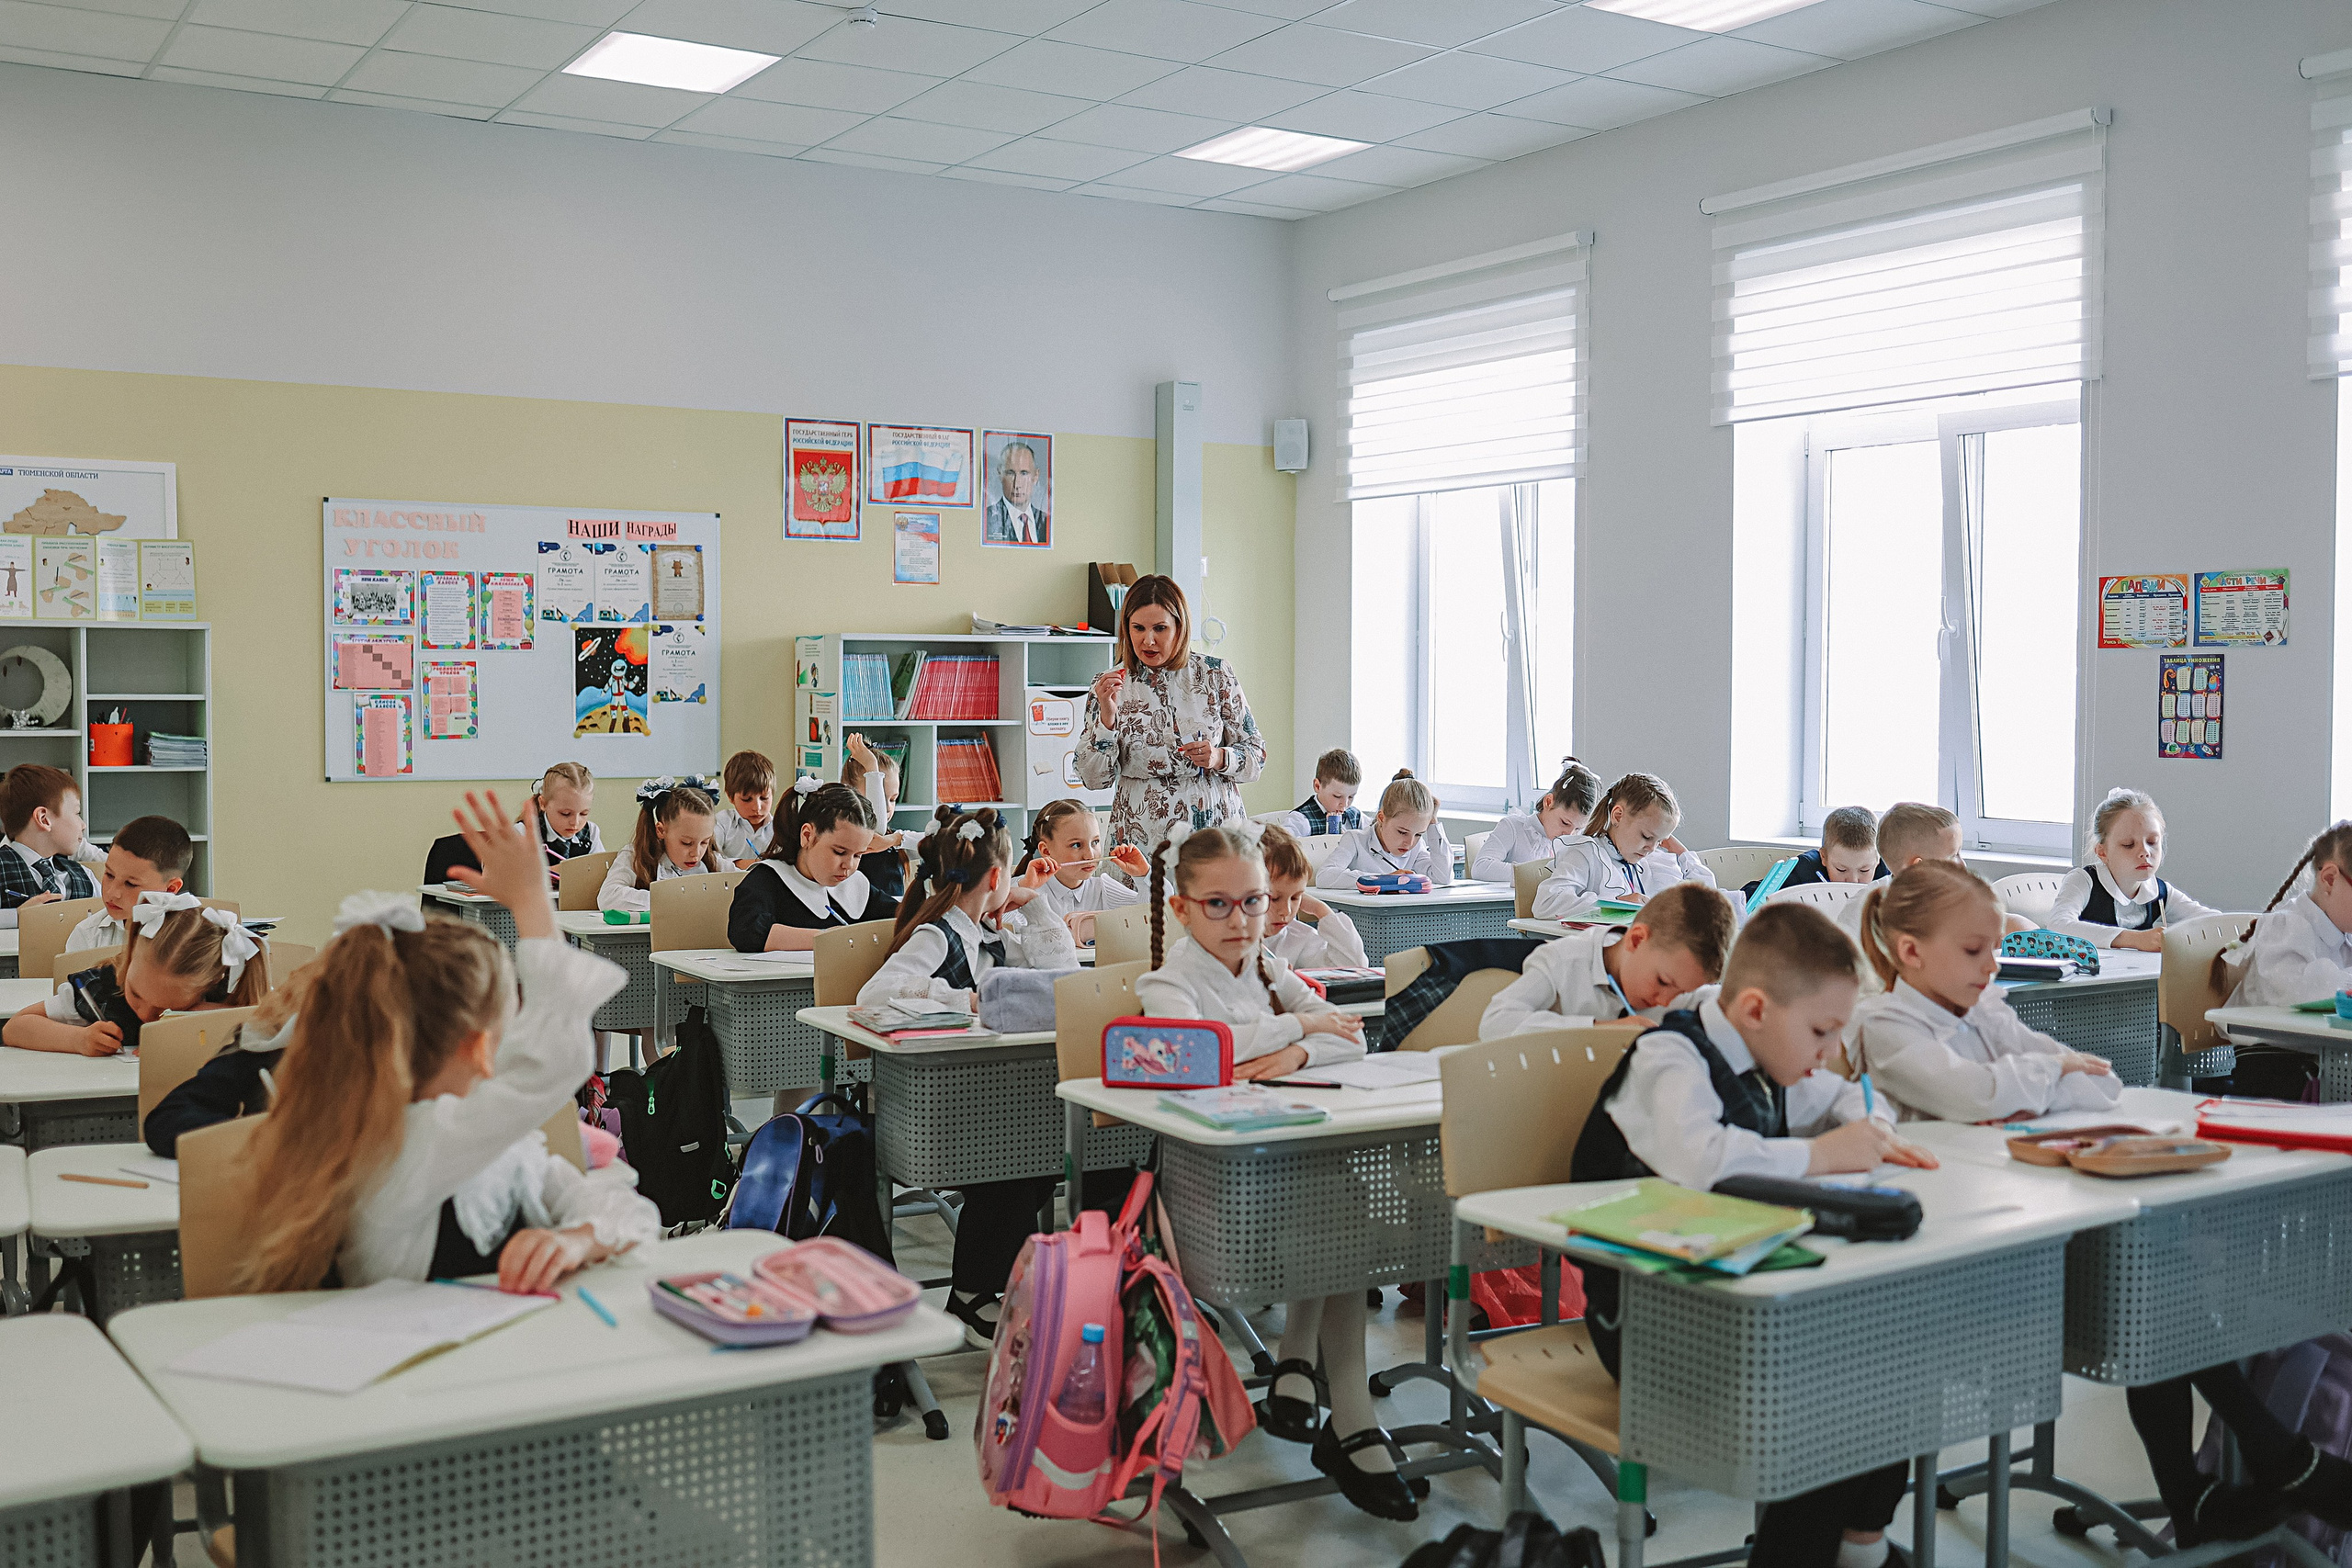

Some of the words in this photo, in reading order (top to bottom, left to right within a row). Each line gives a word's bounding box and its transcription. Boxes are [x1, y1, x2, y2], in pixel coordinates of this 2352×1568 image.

[18, 468, 64, 478] ТЮМЕНСКОЙ
[65, 471, 99, 479] ОБЛАСТИ
[333, 508, 487, 533] КЛАССНЫЙ
[568, 519, 620, 538] НАШИ
[626, 521, 677, 537] НАГРАДЫ
[344, 538, 459, 559] УГОЛОК
[548, 567, 583, 575] ГРАМОТА
[604, 568, 639, 576] ГРАМОТА
[2120, 579, 2165, 593] ПАДЕЖИ
[2215, 577, 2243, 586] ЧАСТИ
[2245, 576, 2267, 585] РЕЧИ
